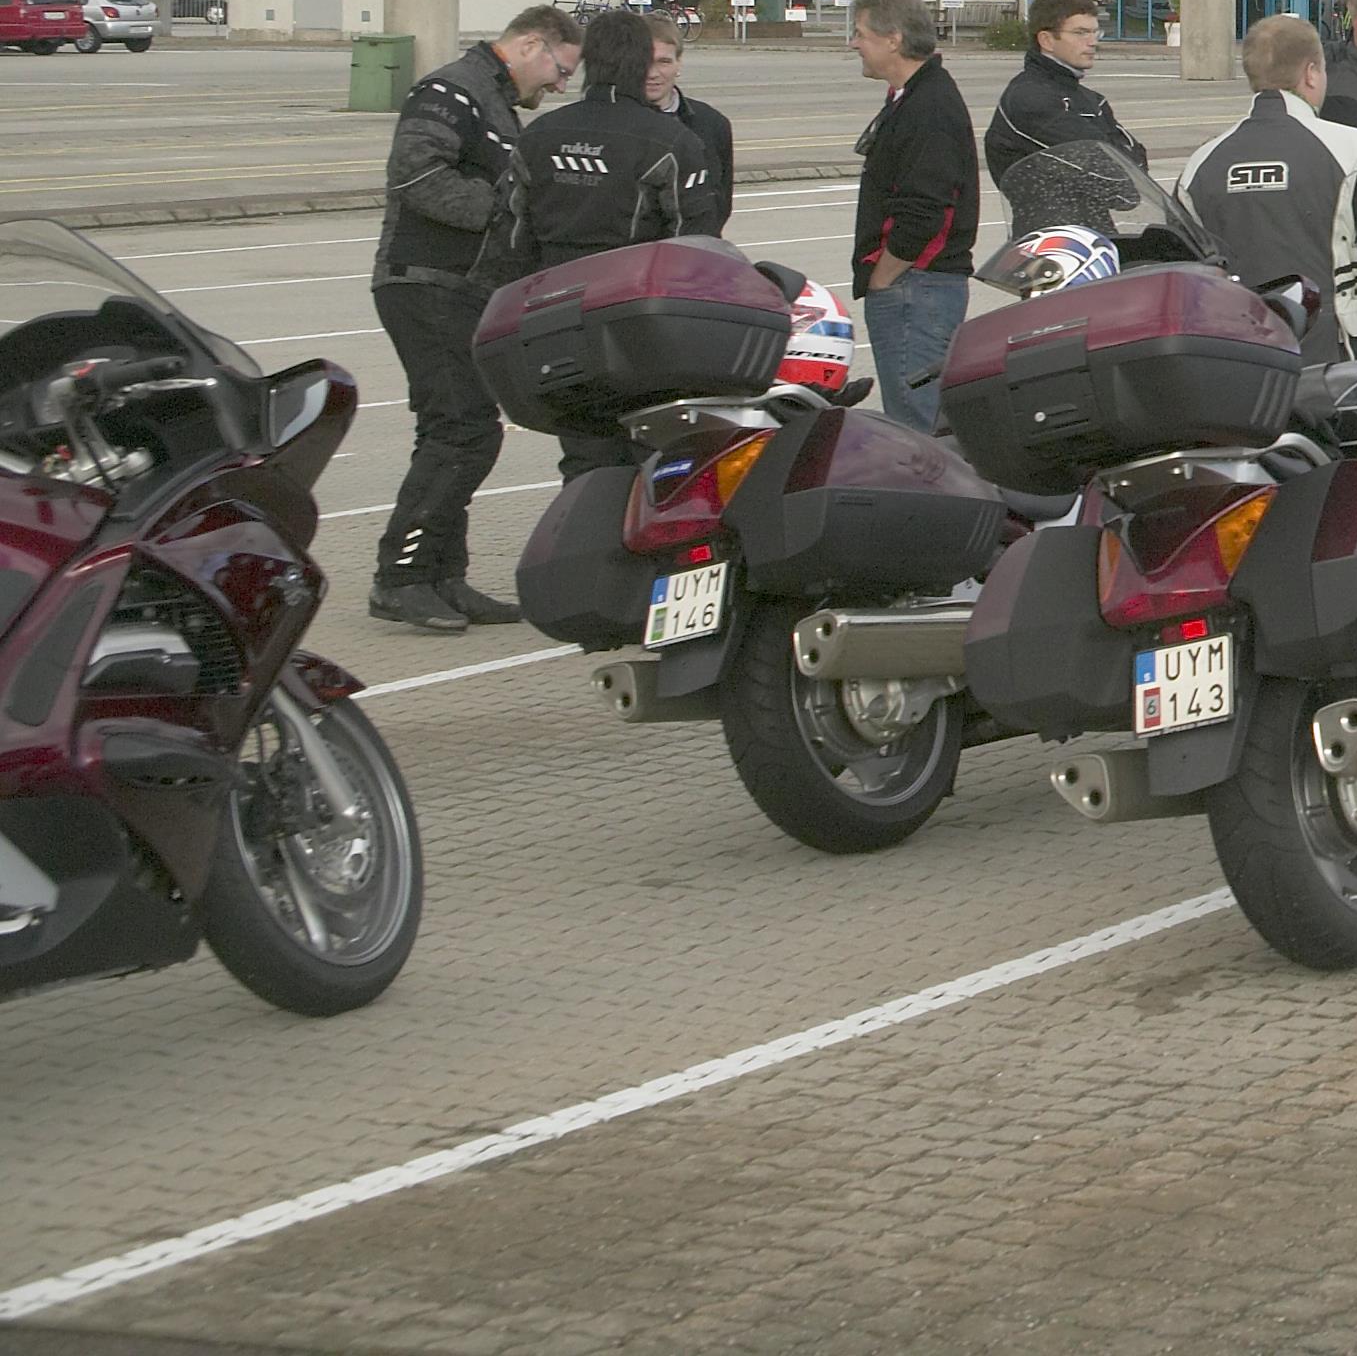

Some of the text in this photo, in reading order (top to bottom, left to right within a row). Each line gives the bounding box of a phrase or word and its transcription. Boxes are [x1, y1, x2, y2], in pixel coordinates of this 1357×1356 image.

[561, 142, 604, 156] rukka
[1230, 164, 1285, 185] STR
[673, 566, 721, 602] UYM
[672, 602, 716, 635] 146
[1165, 641, 1224, 681] UYM
[1146, 699, 1156, 716] 6
[1168, 684, 1224, 722] 143
